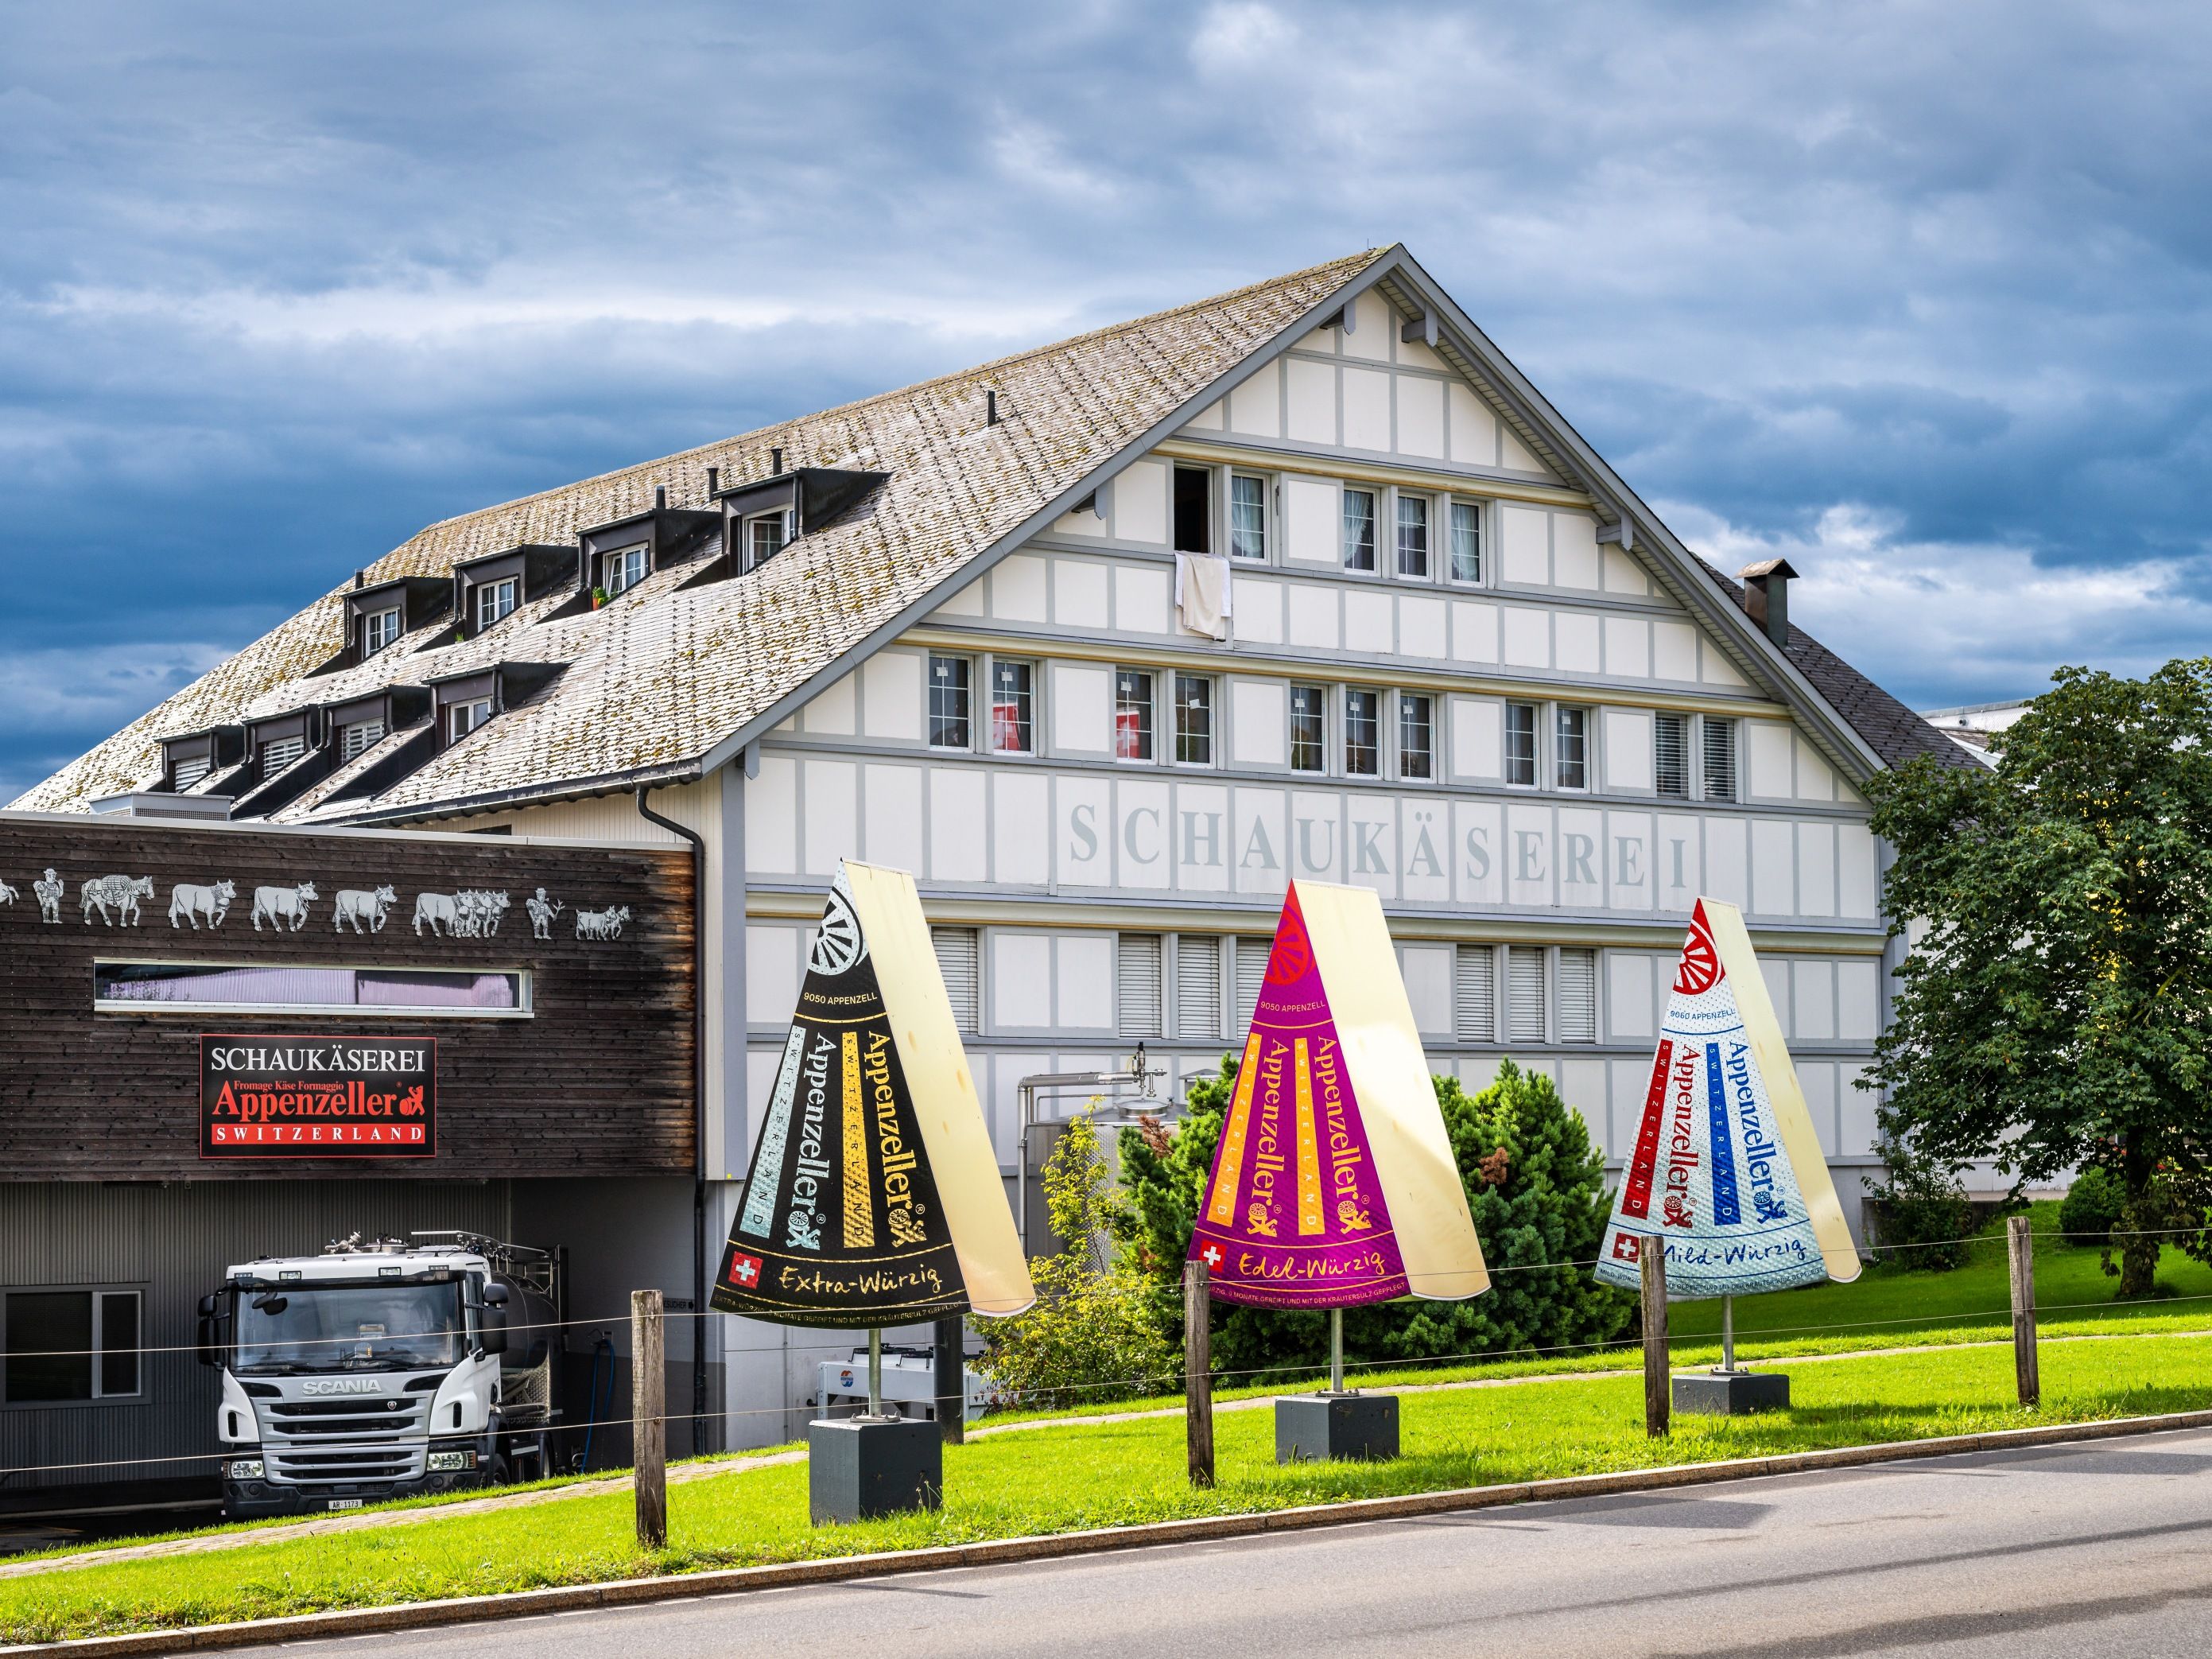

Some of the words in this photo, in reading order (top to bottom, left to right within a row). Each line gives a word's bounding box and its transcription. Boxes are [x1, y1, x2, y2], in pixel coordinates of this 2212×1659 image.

[1070, 804, 1686, 888] SCHAUKÄSEREI
[803, 992, 826, 1004] 9050
[828, 992, 878, 1004] APPENZELL
[1260, 1001, 1280, 1012] 9050
[1282, 1000, 1325, 1012] APPENZELL
[1691, 1008, 1736, 1020] APPENZELL
[211, 1044, 425, 1072] SCHAUKÄSEREI
[211, 1080, 397, 1122] Appenzeller
[234, 1080, 273, 1093] Fromage
[275, 1080, 297, 1090] Käse
[298, 1081, 343, 1093] Formaggio
[1726, 1041, 1777, 1191] Appenzeller
[216, 1126, 422, 1140] SWITZERLAND
[753, 1034, 801, 1225] SWITZERLAND
[791, 1032, 836, 1215] Appenzeller
[847, 1039, 864, 1237] SWITZERLAND
[864, 1031, 917, 1210] Appenzeller
[1217, 1039, 1258, 1215] SWITZERLAND
[1252, 1037, 1290, 1206] Appenzeller
[1298, 1043, 1317, 1226] SWITZERLAND
[1314, 1035, 1362, 1199] Appenzeller
[1632, 1045, 1669, 1209] SWITZERLAND
[1667, 1044, 1701, 1199] Appenzeller
[1709, 1048, 1732, 1216] SWITZERLAND
[778, 1263, 943, 1294] Extra-Würzig
[1233, 1292, 1259, 1302] MONATE
[1260, 1296, 1286, 1304] GEREIFT
[1374, 1282, 1406, 1296] GEPFLEGT
[1239, 1251, 1385, 1280] Edel-Würzig
[301, 1379, 382, 1395] SCANIA
